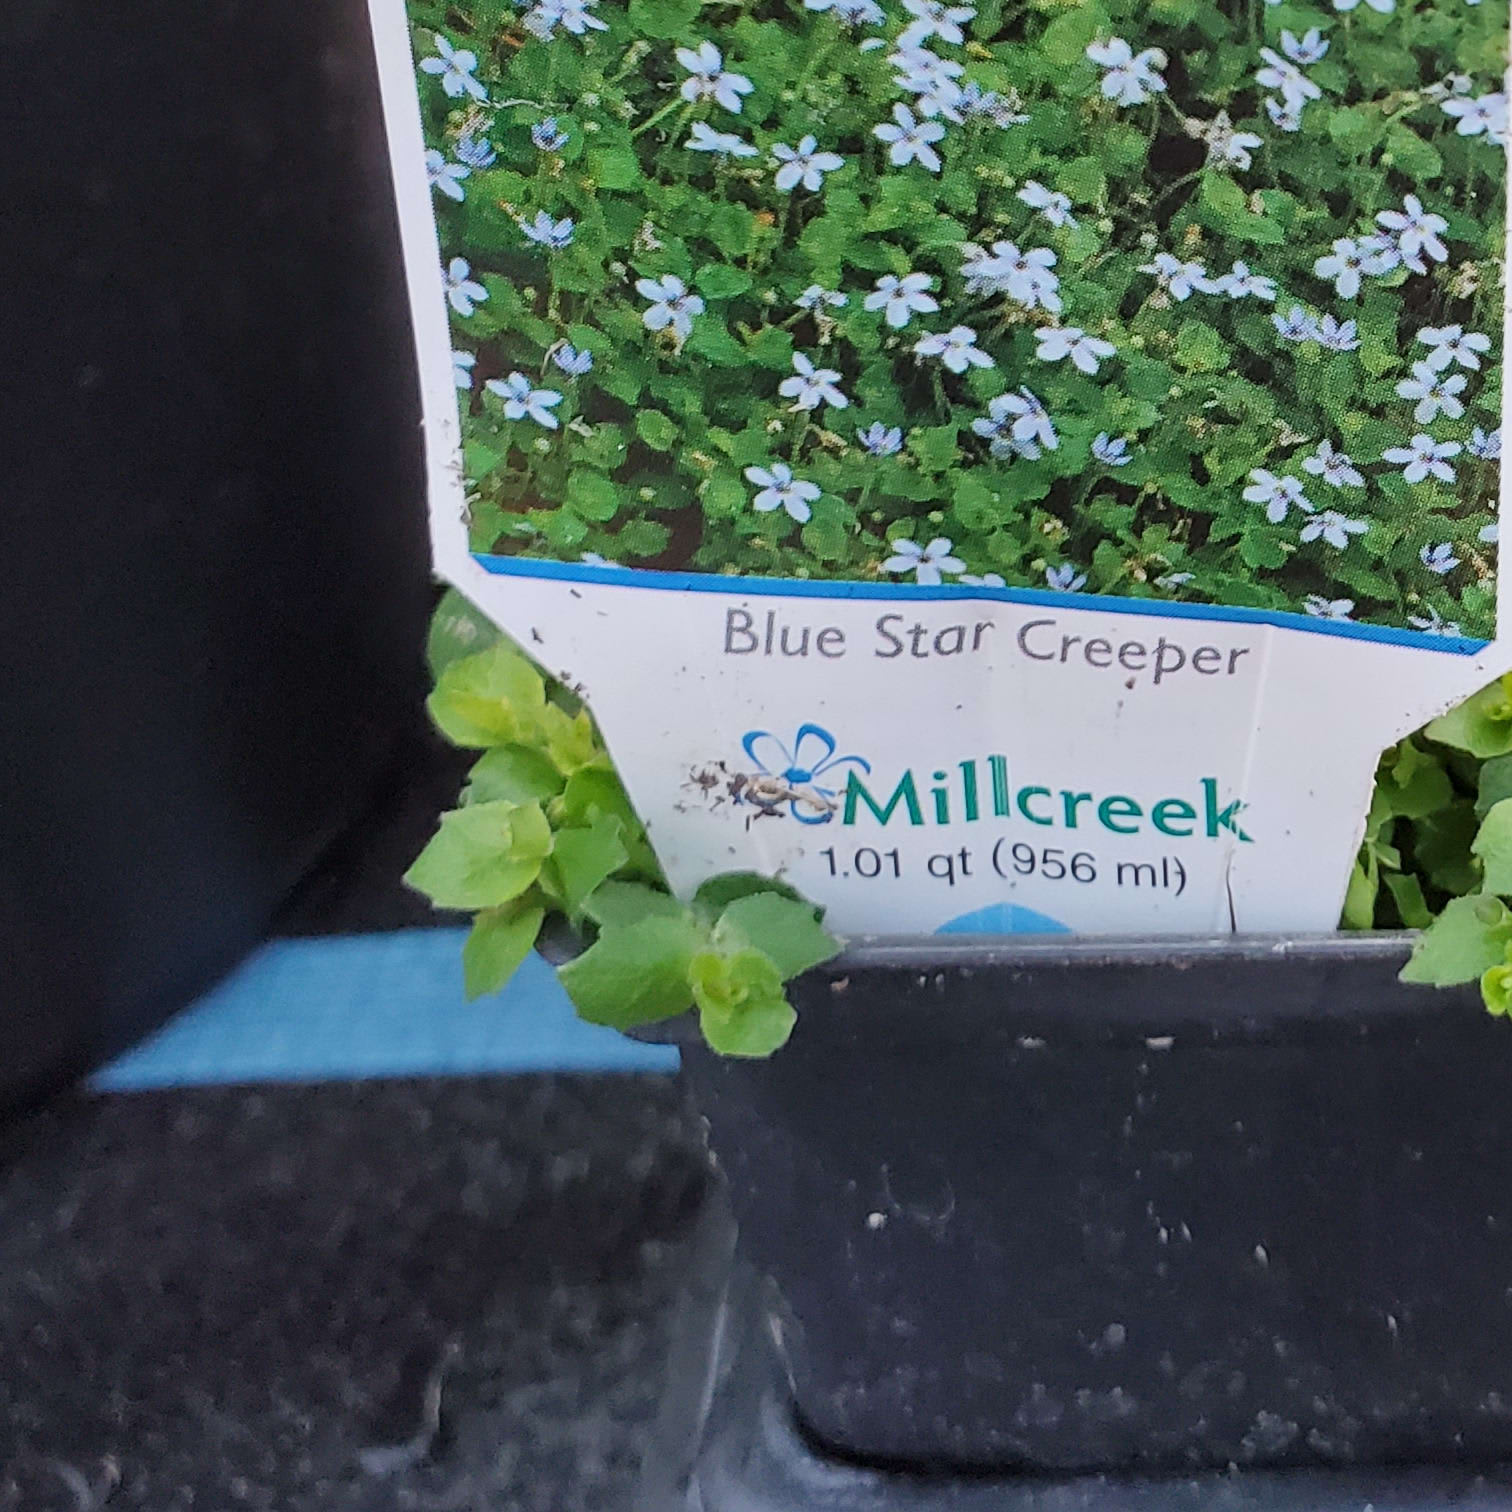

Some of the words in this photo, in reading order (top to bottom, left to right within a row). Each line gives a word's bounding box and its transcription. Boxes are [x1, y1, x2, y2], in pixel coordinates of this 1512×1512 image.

[723, 604, 848, 659] Blue
[874, 613, 995, 660] Star
[1017, 618, 1251, 686] Creeper
[842, 754, 1254, 843] Millcreek
[819, 845, 904, 881] 1.01
[926, 843, 972, 886] qt
[993, 841, 1098, 885] (956
[1115, 849, 1188, 896] ml)
